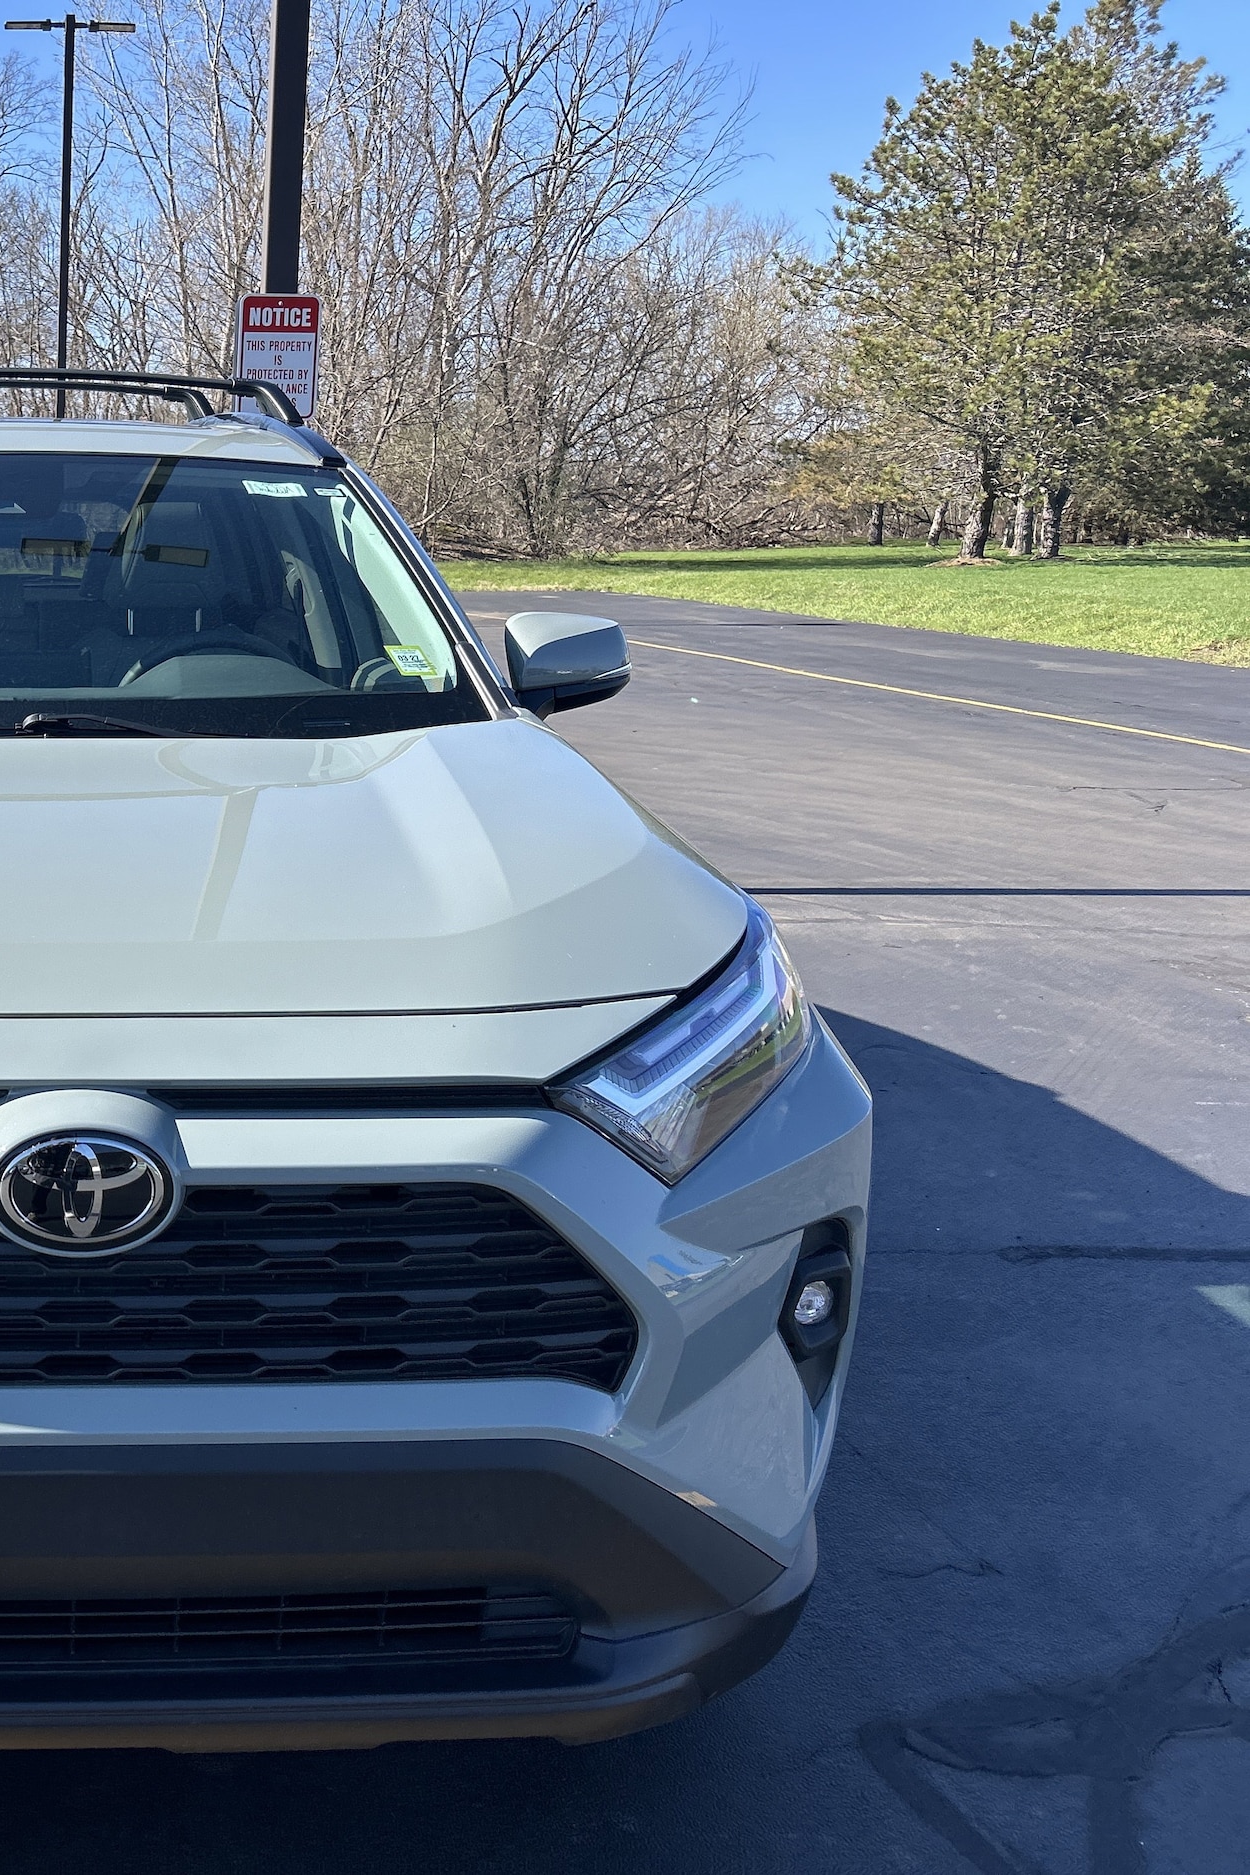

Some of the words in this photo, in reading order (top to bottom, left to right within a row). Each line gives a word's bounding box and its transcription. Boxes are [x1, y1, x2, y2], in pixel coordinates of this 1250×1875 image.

[249, 307, 312, 327] NOTICE
[246, 340, 266, 351] THIS
[269, 340, 313, 352] PROPERTY
[274, 354, 283, 366] IS
[246, 368, 294, 380] PROTECTED
[297, 369, 309, 380] BY
